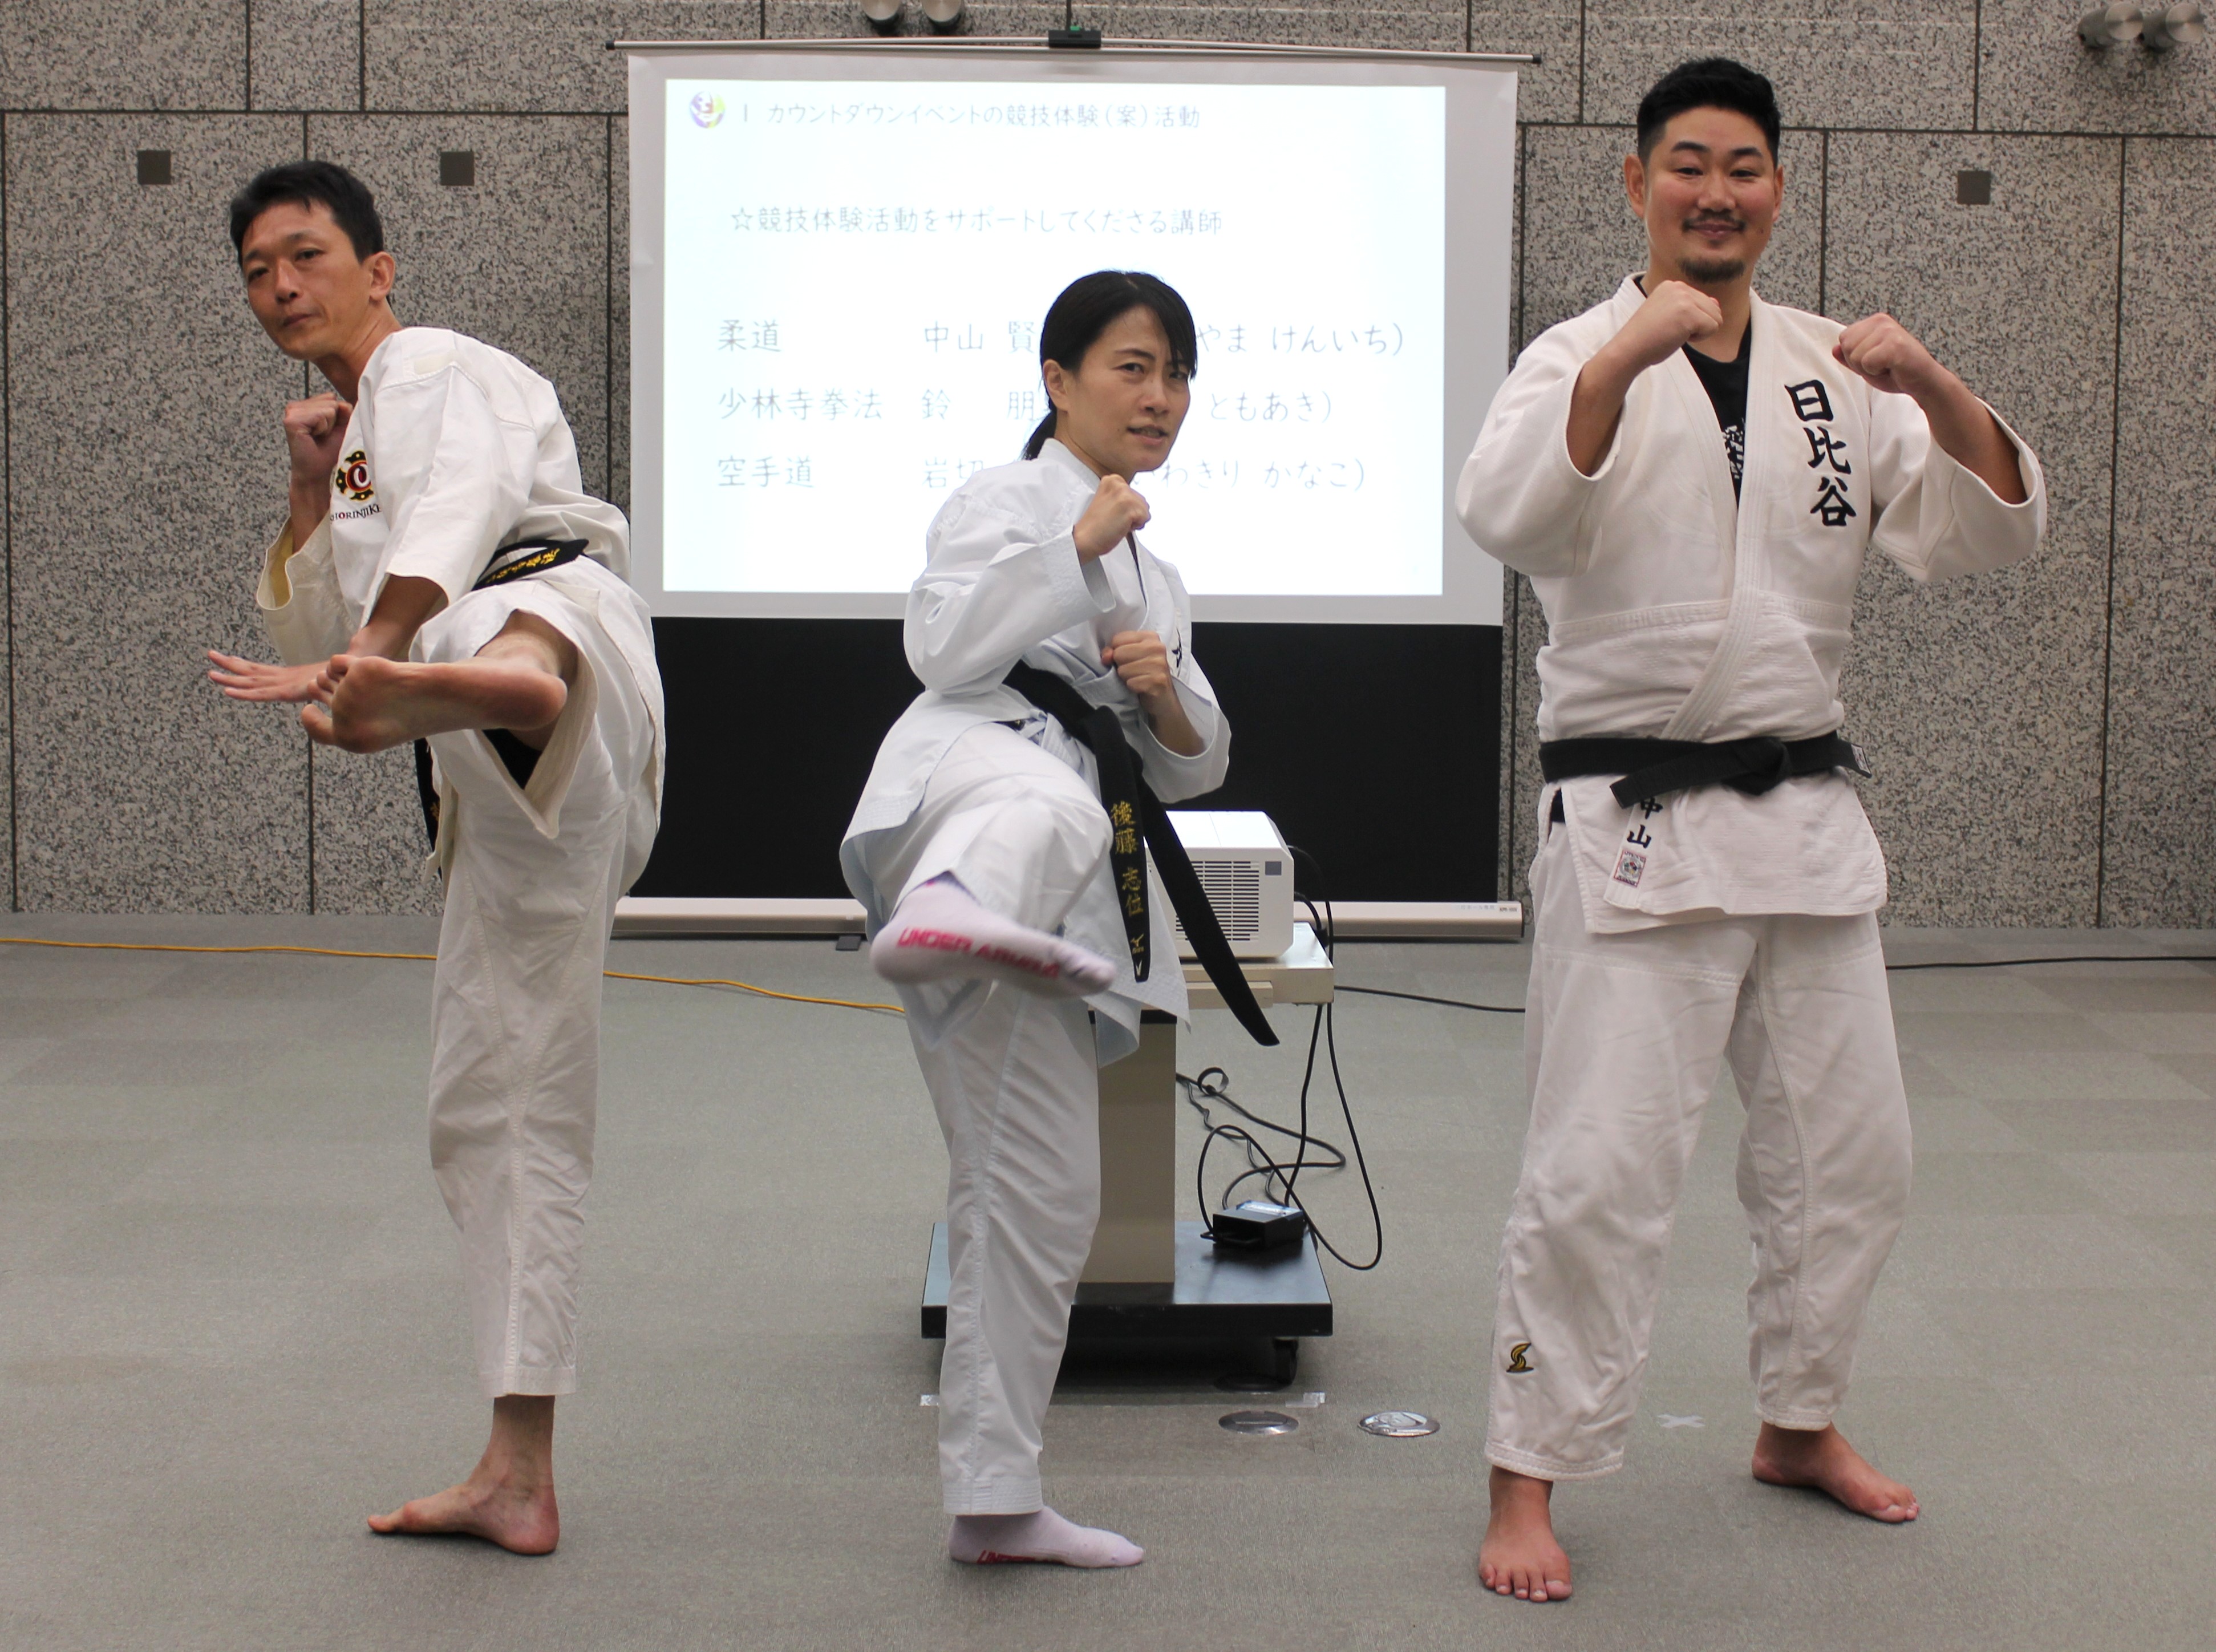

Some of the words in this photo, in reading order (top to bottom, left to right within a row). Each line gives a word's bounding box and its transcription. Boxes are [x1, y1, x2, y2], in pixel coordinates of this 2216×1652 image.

[718, 319, 782, 354] 柔道
[924, 320, 984, 354] 中山
[1008, 321, 1036, 354] 賢
[1272, 322, 1403, 357] けんいち）
[718, 387, 883, 422] 少林寺拳法
[921, 388, 951, 420] 鈴
[1210, 390, 1332, 424] ともあき）
[1784, 379, 1856, 526] 日比谷
[718, 455, 815, 489] 空手道
[1265, 458, 1366, 493] かなこ）
[1627, 797, 1663, 849] 中山
